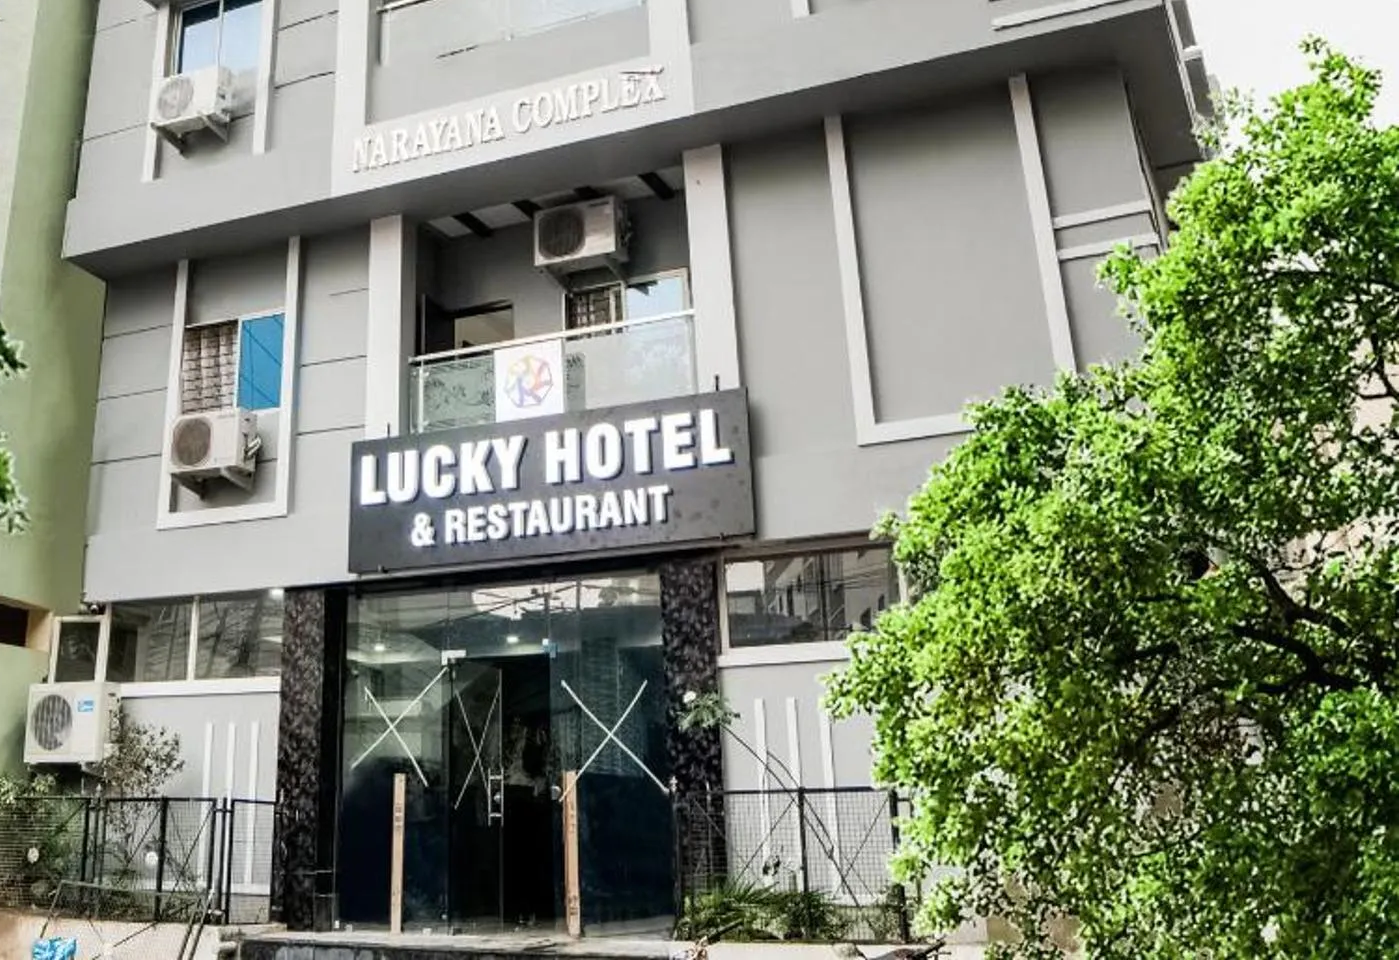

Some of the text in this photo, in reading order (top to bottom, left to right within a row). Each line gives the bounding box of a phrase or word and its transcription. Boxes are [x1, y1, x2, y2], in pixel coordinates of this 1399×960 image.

[351, 106, 506, 173] NARAYANA
[360, 408, 734, 507] LUCKY HOTEL
[411, 485, 673, 547] & RESTAURANT
